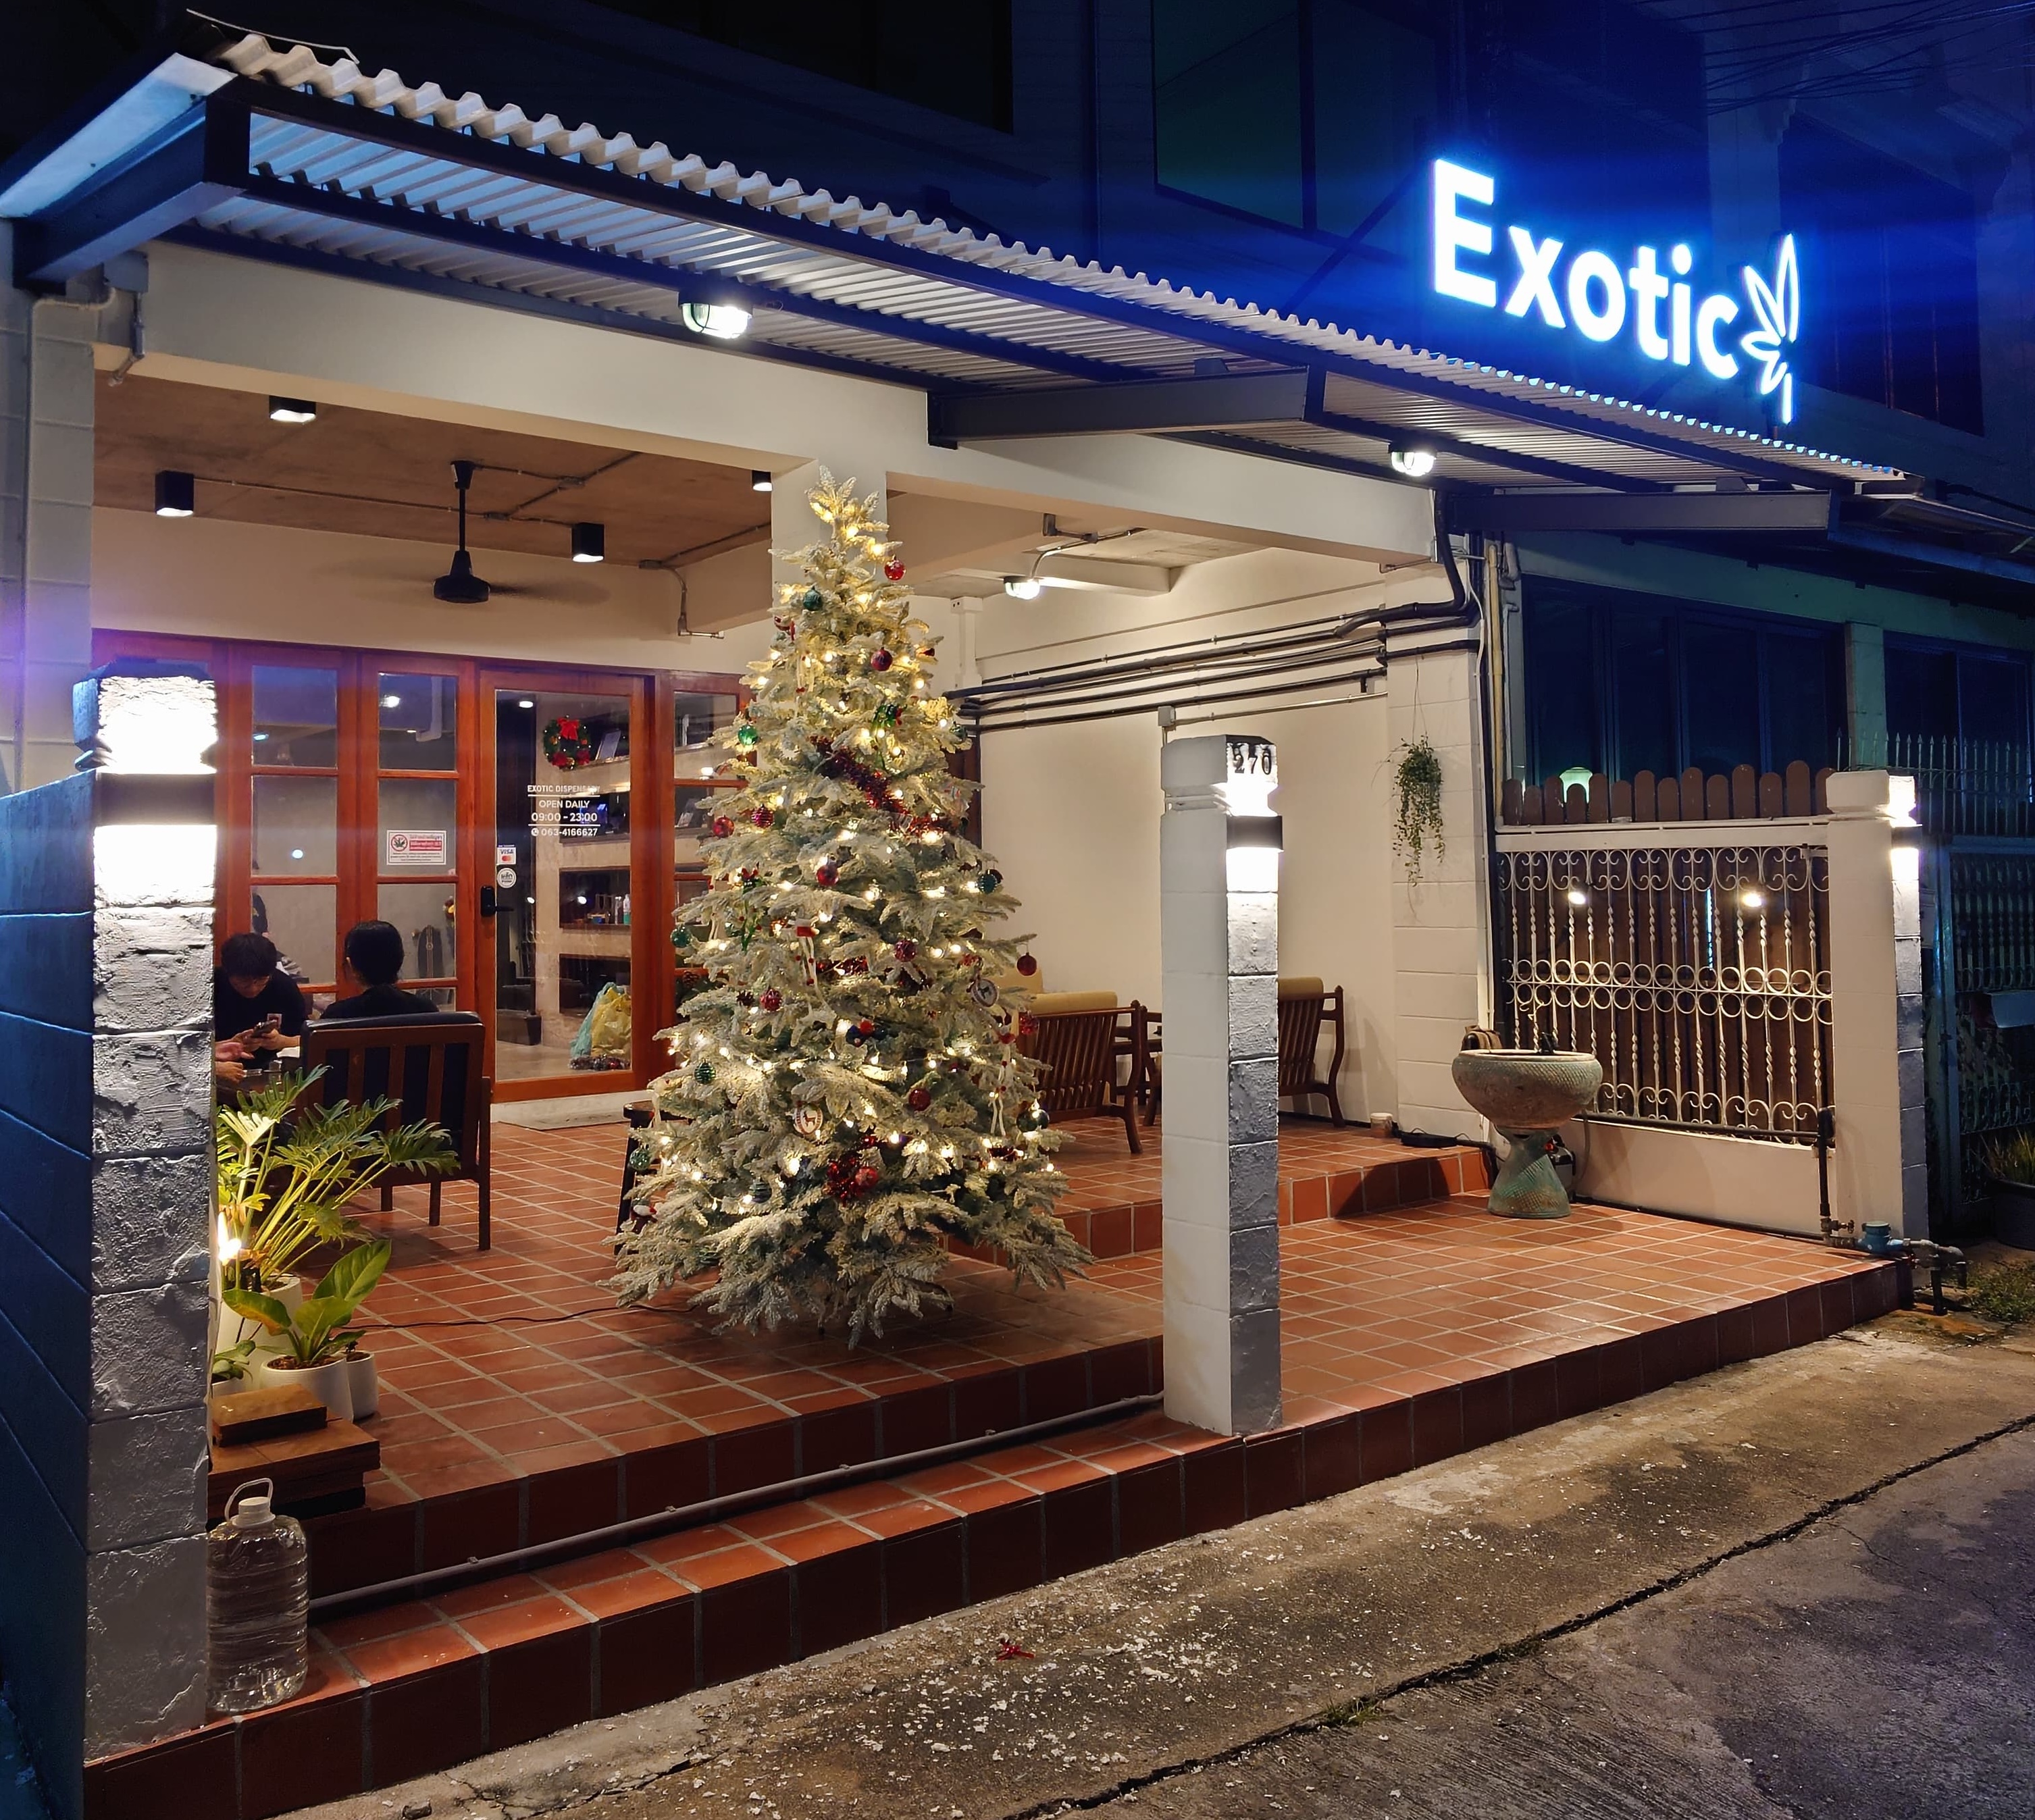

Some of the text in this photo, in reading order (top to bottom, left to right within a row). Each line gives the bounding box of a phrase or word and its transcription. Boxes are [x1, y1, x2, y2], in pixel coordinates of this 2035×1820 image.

[1433, 158, 1740, 380] Exotic
[1233, 754, 1272, 775] 270
[539, 800, 590, 808] OPEN DAILY
[531, 812, 561, 821] 09:00
[569, 812, 597, 821] 23:00
[541, 828, 598, 836] 063-4166627
